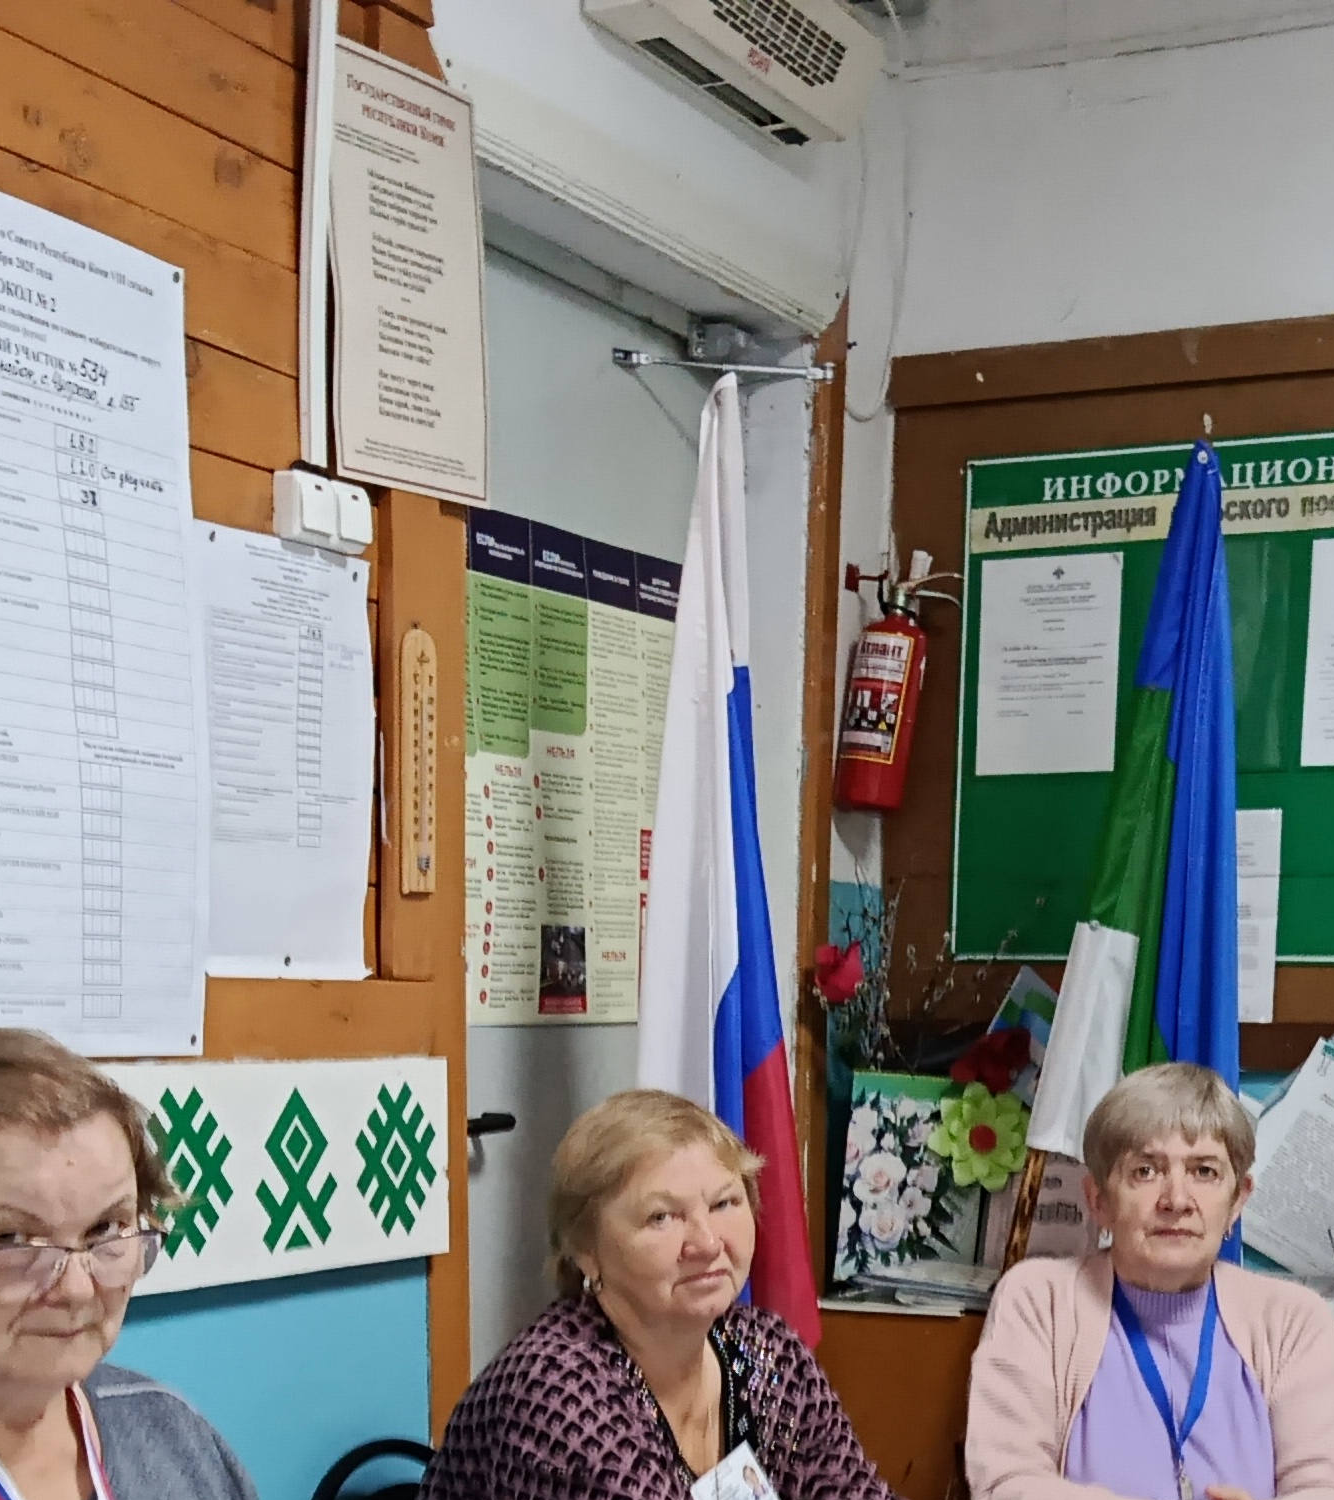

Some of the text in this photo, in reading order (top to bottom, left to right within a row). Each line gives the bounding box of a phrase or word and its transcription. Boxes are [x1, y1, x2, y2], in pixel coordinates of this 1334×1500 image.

[80, 357, 108, 387] 534
[983, 506, 1158, 542] Администрация
[1220, 497, 1290, 522] ского
